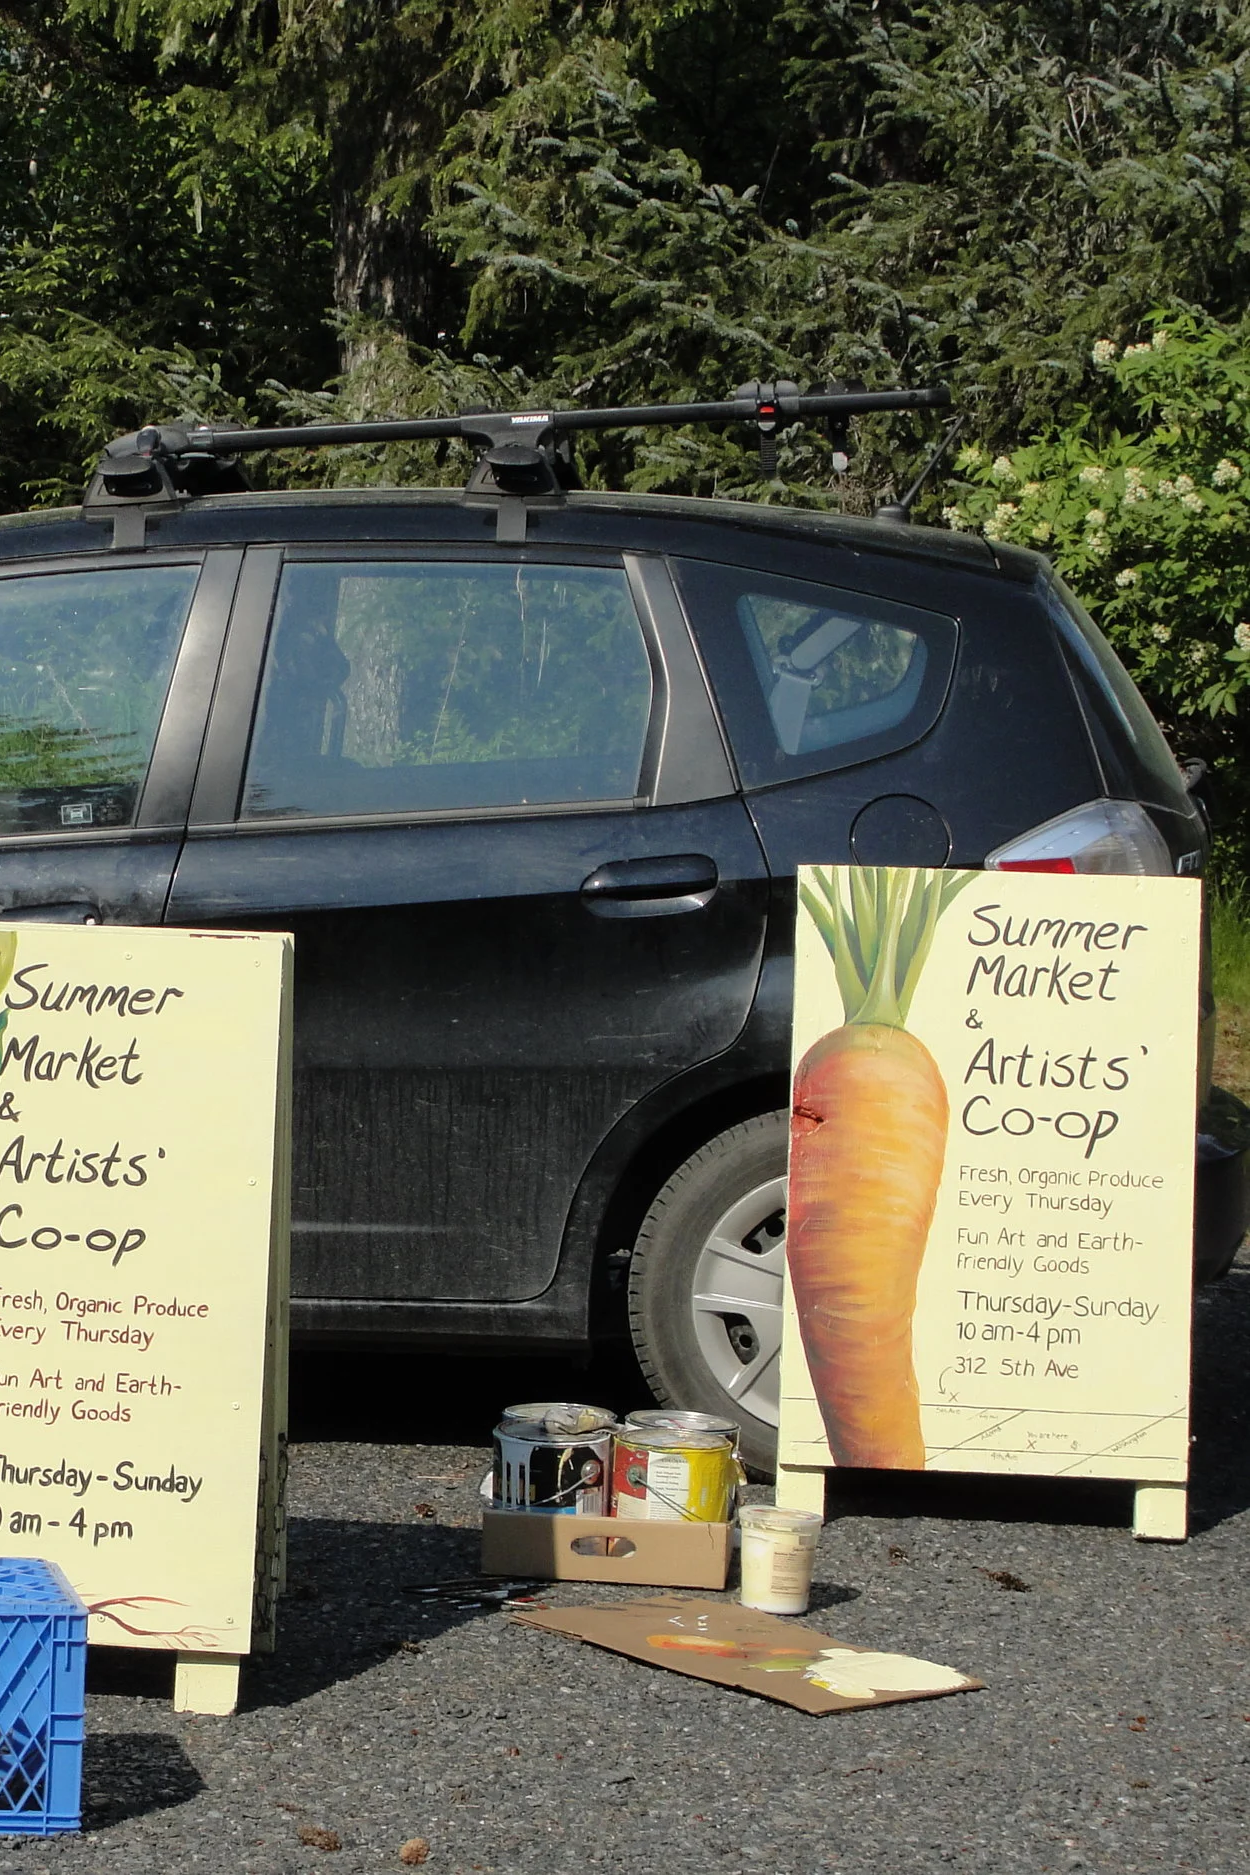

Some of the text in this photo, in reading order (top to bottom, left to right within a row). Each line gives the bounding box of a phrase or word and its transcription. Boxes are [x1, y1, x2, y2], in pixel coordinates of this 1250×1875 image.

[511, 415, 549, 424] YAKIMA
[968, 905, 1148, 952] Summer
[4, 960, 184, 1018] Summer
[966, 955, 1120, 1005] Market
[965, 1009, 983, 1030] &
[0, 1034, 143, 1089] Market
[964, 1038, 1148, 1090] Artists'
[962, 1095, 1119, 1159] Co-op
[960, 1165, 1163, 1189] Fresh, Organic Produce
[959, 1191, 1113, 1220] Every Thursday
[958, 1228, 1142, 1251] Fun Art and Earth-
[1034, 1256, 1089, 1274] Goods
[56, 1292, 122, 1317] Organic
[134, 1295, 209, 1318] Produce
[60, 1321, 154, 1352] Thursday
[956, 1322, 976, 1340] 10
[1047, 1328, 1080, 1351] pm
[955, 1356, 1078, 1378] 312 5th Ave
[29, 1368, 63, 1389] Art
[75, 1373, 105, 1392] and
[116, 1373, 181, 1396] Earth-
[72, 1400, 131, 1422] Goods
[94, 1521, 133, 1546] pm
